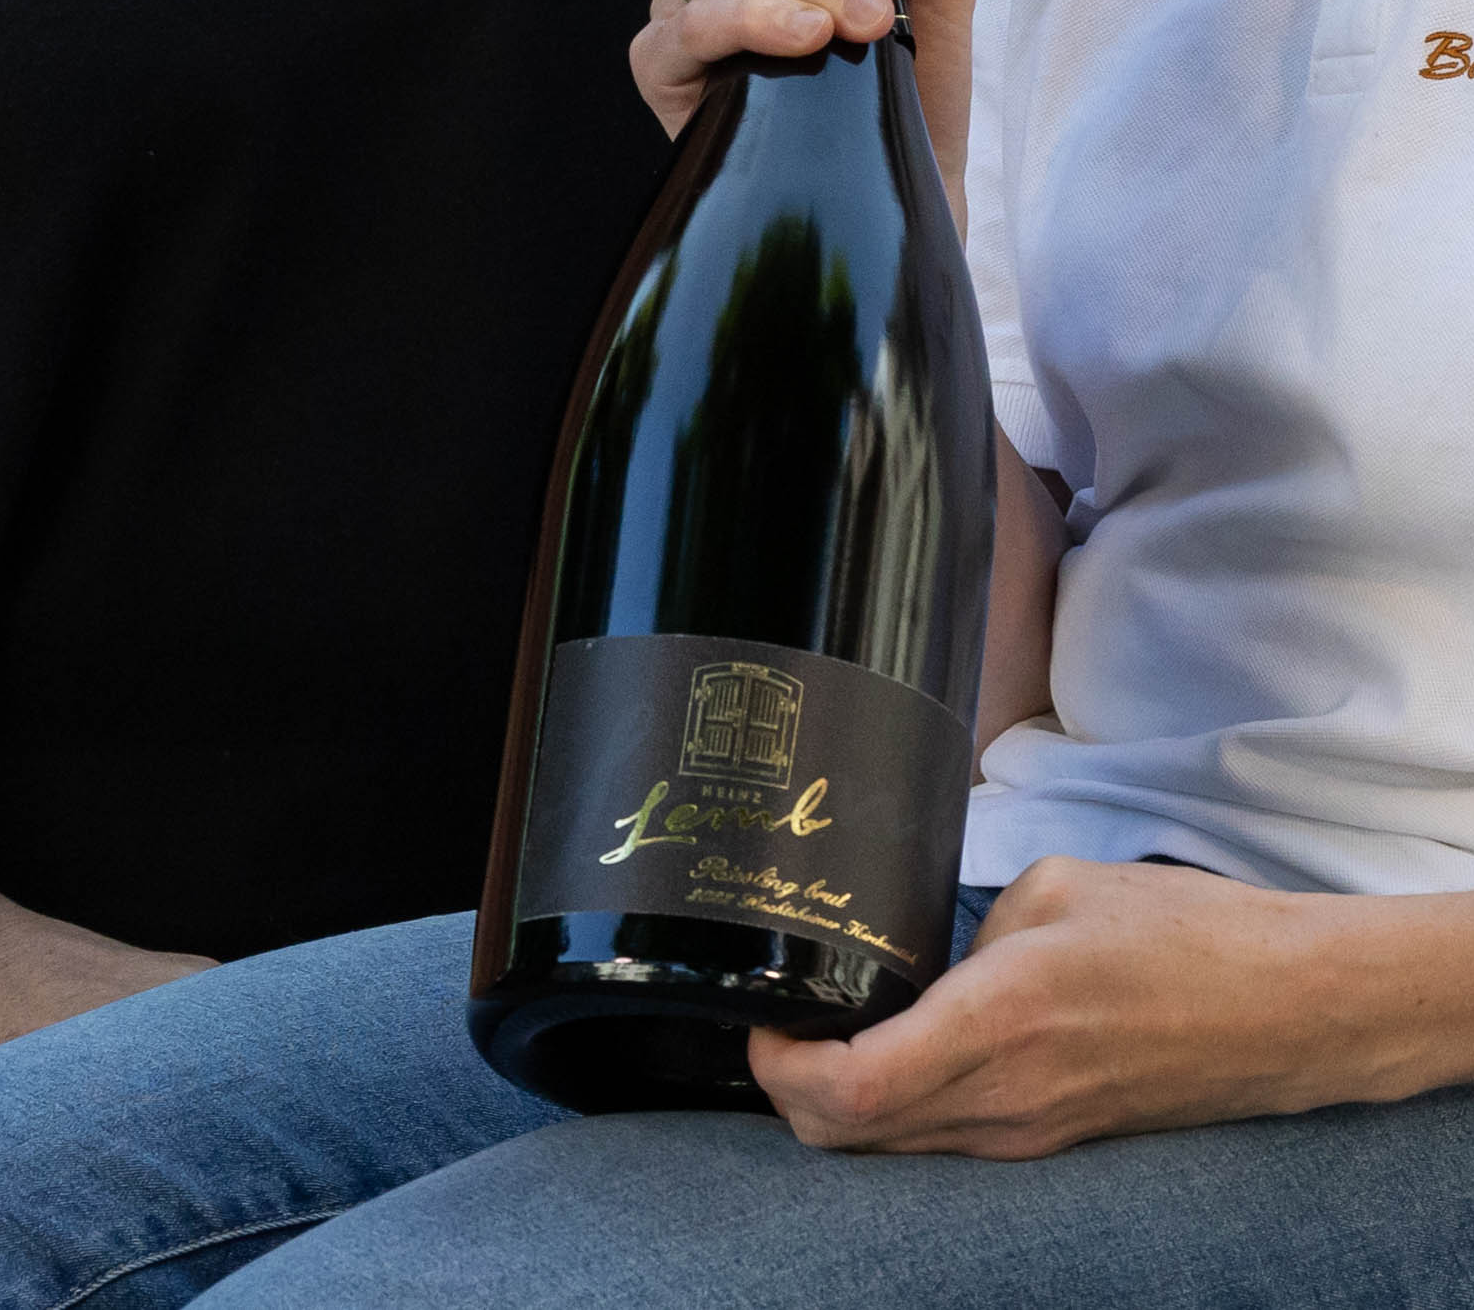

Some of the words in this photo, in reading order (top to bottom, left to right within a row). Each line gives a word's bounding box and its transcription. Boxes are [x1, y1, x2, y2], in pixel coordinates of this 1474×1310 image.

[598, 777, 833, 865] Lemb
[688, 855, 800, 899] Riesling
[804, 879, 852, 908] brut
